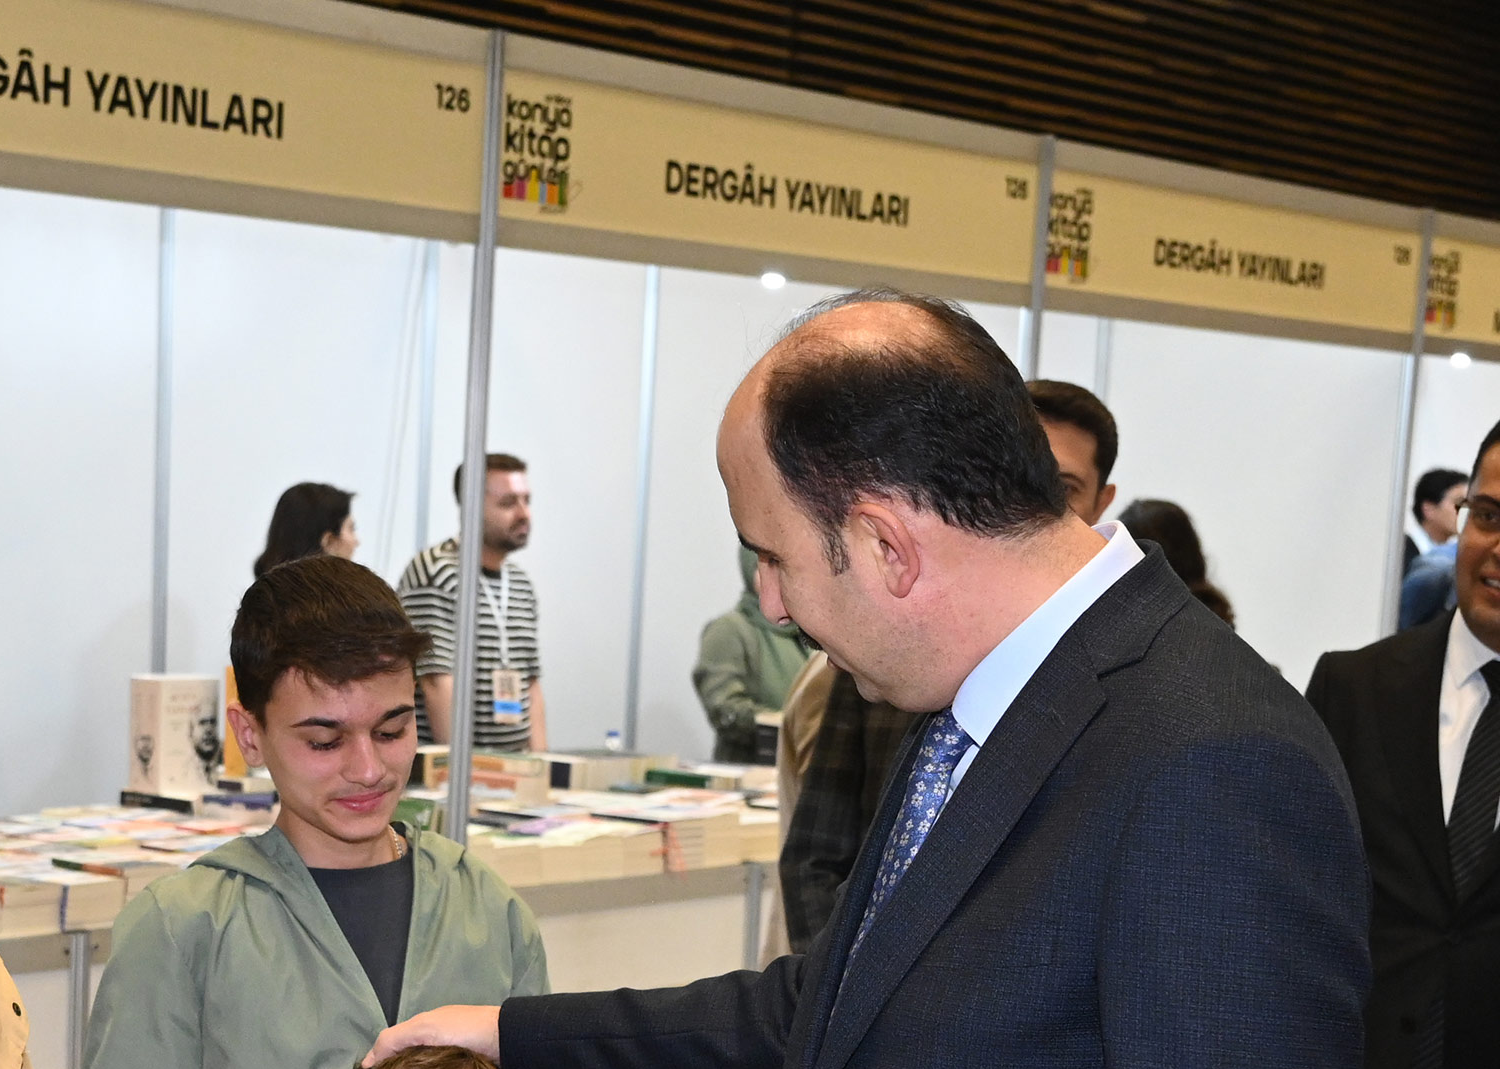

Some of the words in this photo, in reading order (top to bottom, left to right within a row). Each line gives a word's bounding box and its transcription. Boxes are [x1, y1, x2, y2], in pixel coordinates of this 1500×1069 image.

[85, 69, 285, 140] YAYINLARI
[435, 82, 471, 113] 126
[506, 93, 572, 133] konya
[504, 122, 570, 168] kitap
[665, 160, 777, 208] DERGÂH
[785, 178, 910, 228] YAYINLARI
[1154, 238, 1233, 276] DERGÂH
